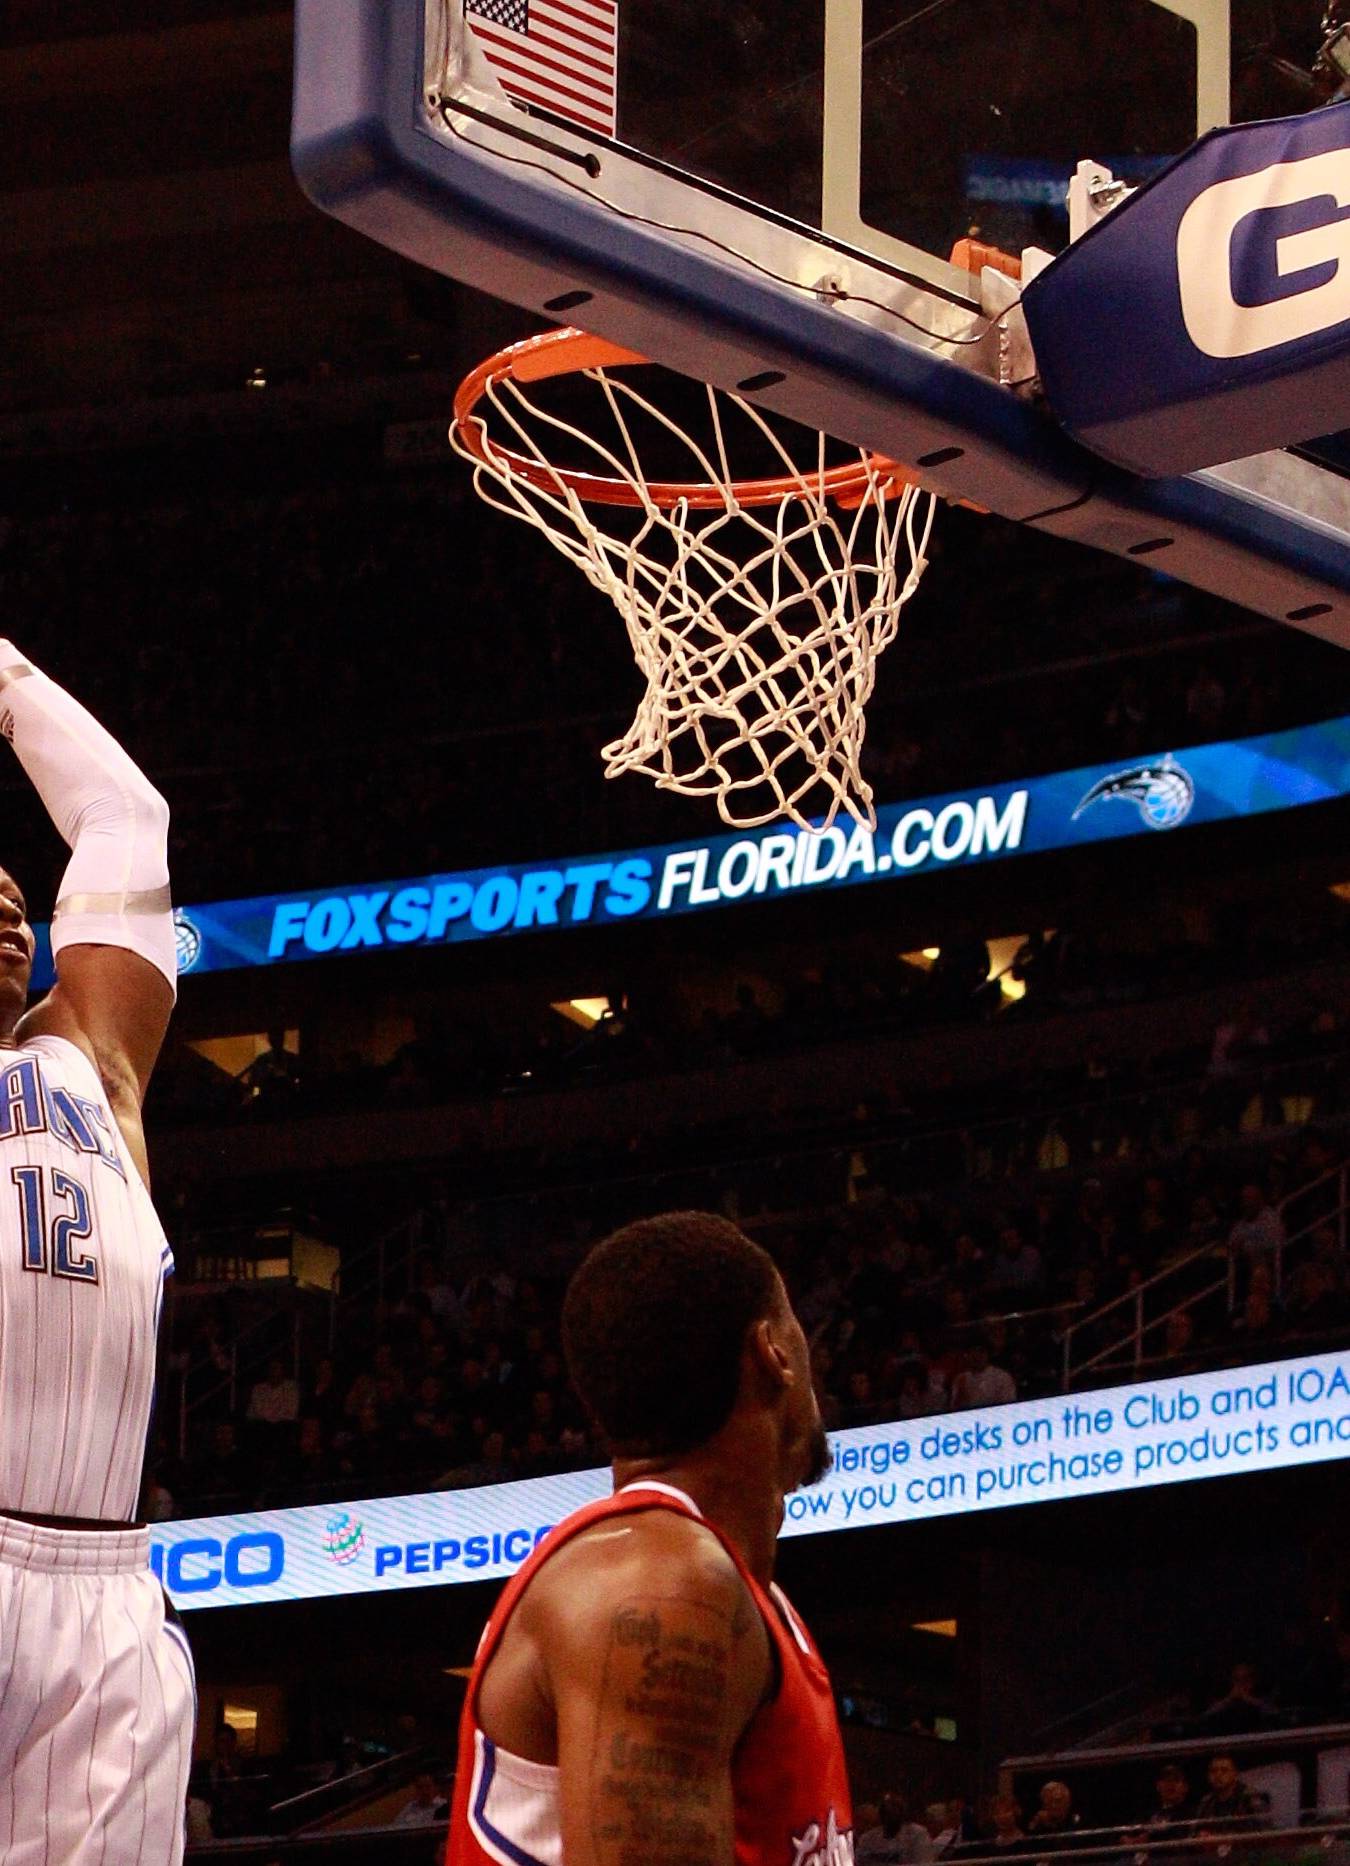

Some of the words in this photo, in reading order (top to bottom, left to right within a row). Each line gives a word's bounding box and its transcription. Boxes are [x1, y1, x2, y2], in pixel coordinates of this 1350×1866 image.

[11, 1165, 99, 1285] 12
[834, 1438, 911, 1475] ierge
[919, 1422, 1003, 1462] desks
[1012, 1416, 1052, 1447] on
[1063, 1406, 1114, 1437] the
[1123, 1388, 1200, 1430] Club
[1211, 1375, 1277, 1416] and
[841, 1482, 898, 1519] you
[906, 1473, 966, 1504] can
[975, 1447, 1123, 1500] purchase
[1134, 1423, 1280, 1478] products
[151, 1530, 286, 1594] ICO
